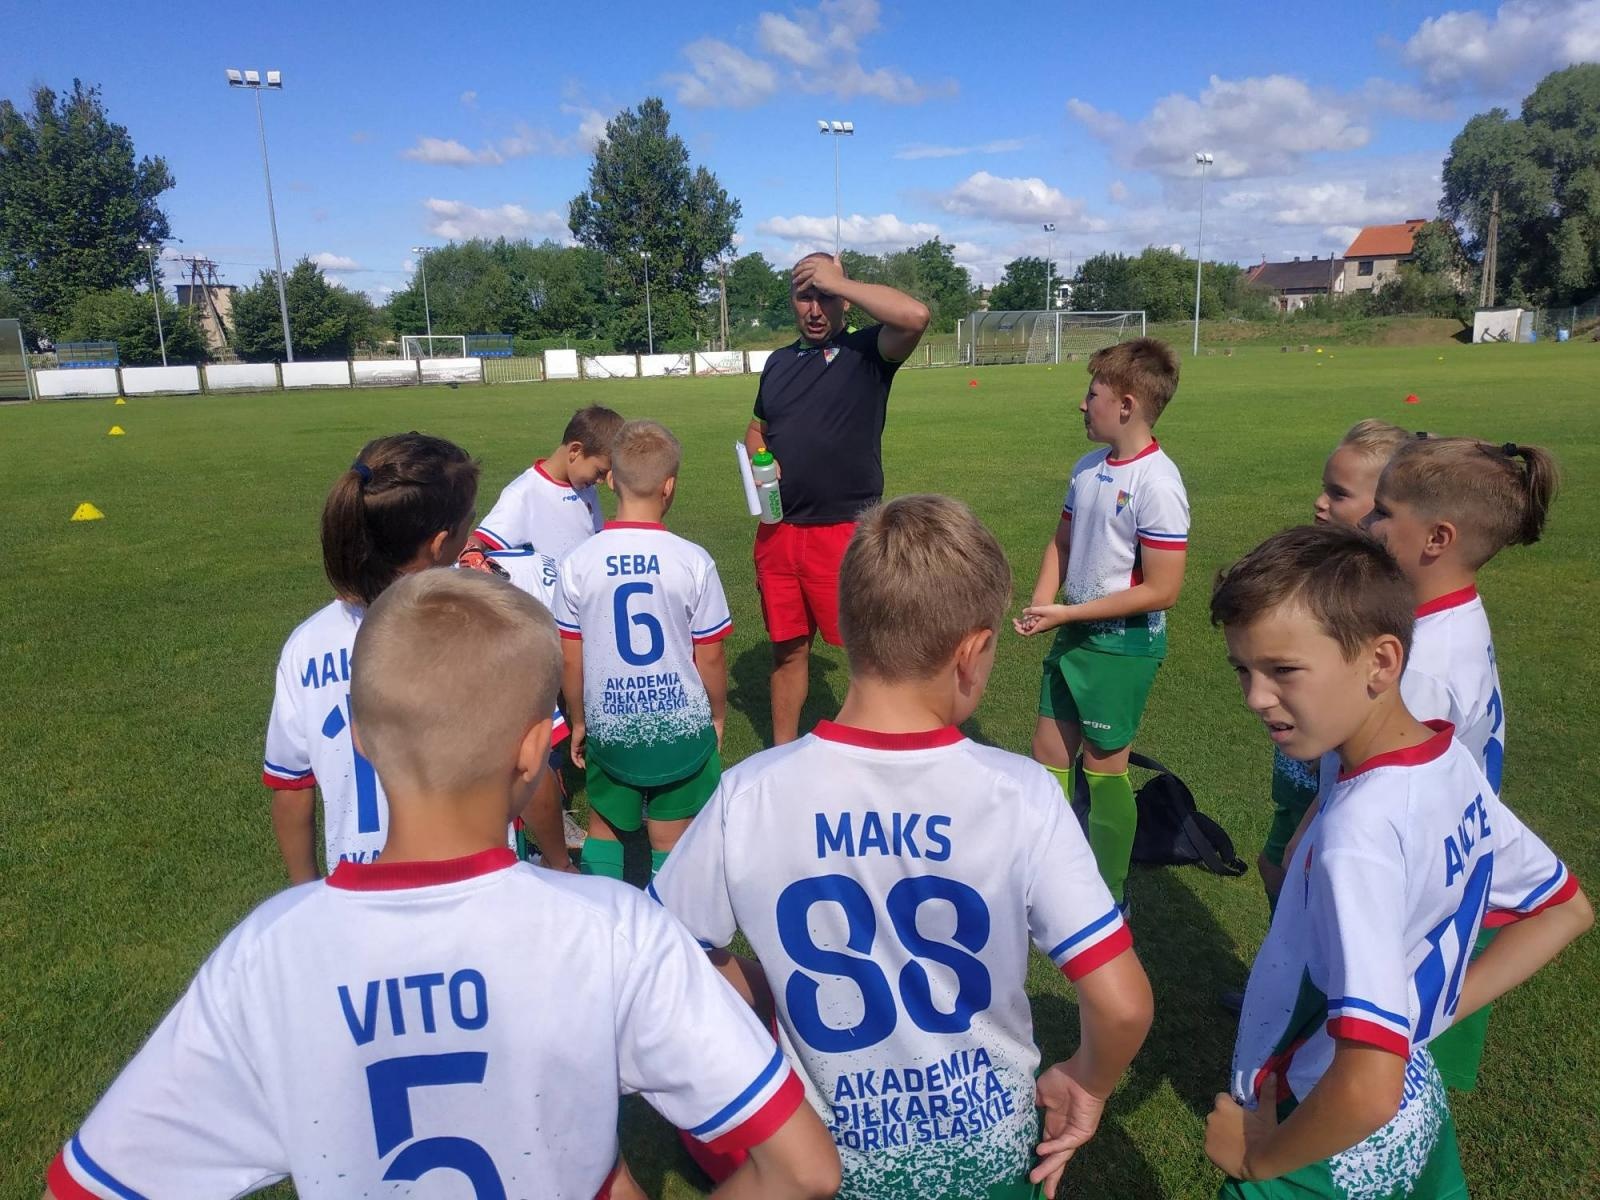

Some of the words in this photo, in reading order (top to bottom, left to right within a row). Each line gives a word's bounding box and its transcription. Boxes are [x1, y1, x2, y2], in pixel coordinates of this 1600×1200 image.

[606, 554, 661, 577] SEBA
[613, 581, 665, 667] 6
[604, 684, 686, 704] PIŁKARSKA
[606, 672, 681, 690] AKADEMIA
[815, 811, 951, 862] MAKS
[776, 873, 992, 1053] 88
[337, 968, 489, 1047] VITO
[833, 1070, 1004, 1130] PIŁKARSKA
[834, 1047, 992, 1102] AKADEMIA
[365, 1051, 508, 1200] 5
